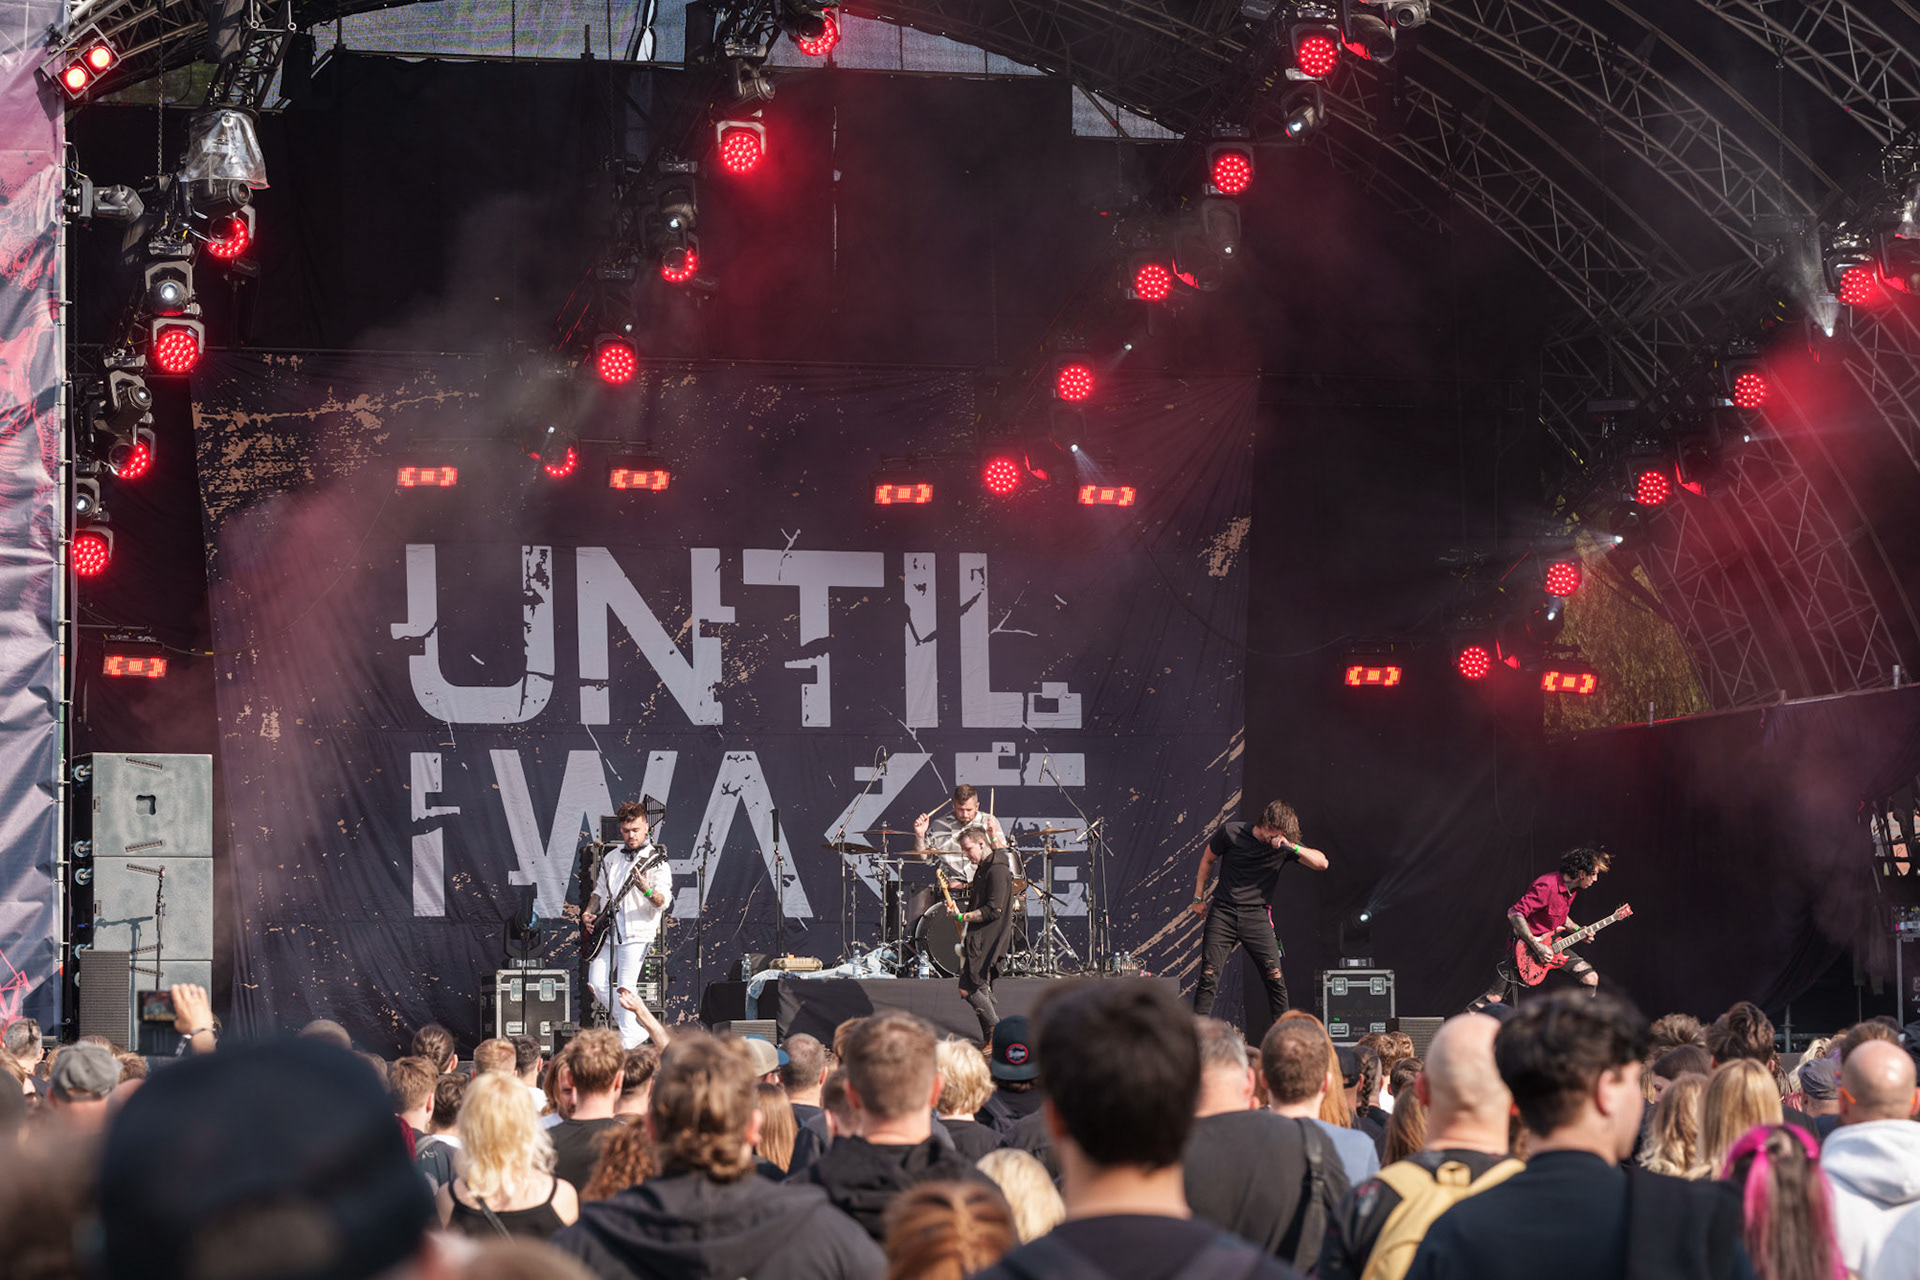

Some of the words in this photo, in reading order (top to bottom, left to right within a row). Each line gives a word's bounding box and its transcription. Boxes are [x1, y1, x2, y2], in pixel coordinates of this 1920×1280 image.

[391, 544, 1082, 729] UNTIL
[411, 752, 460, 917] I
[489, 742, 1089, 918] WAKE
